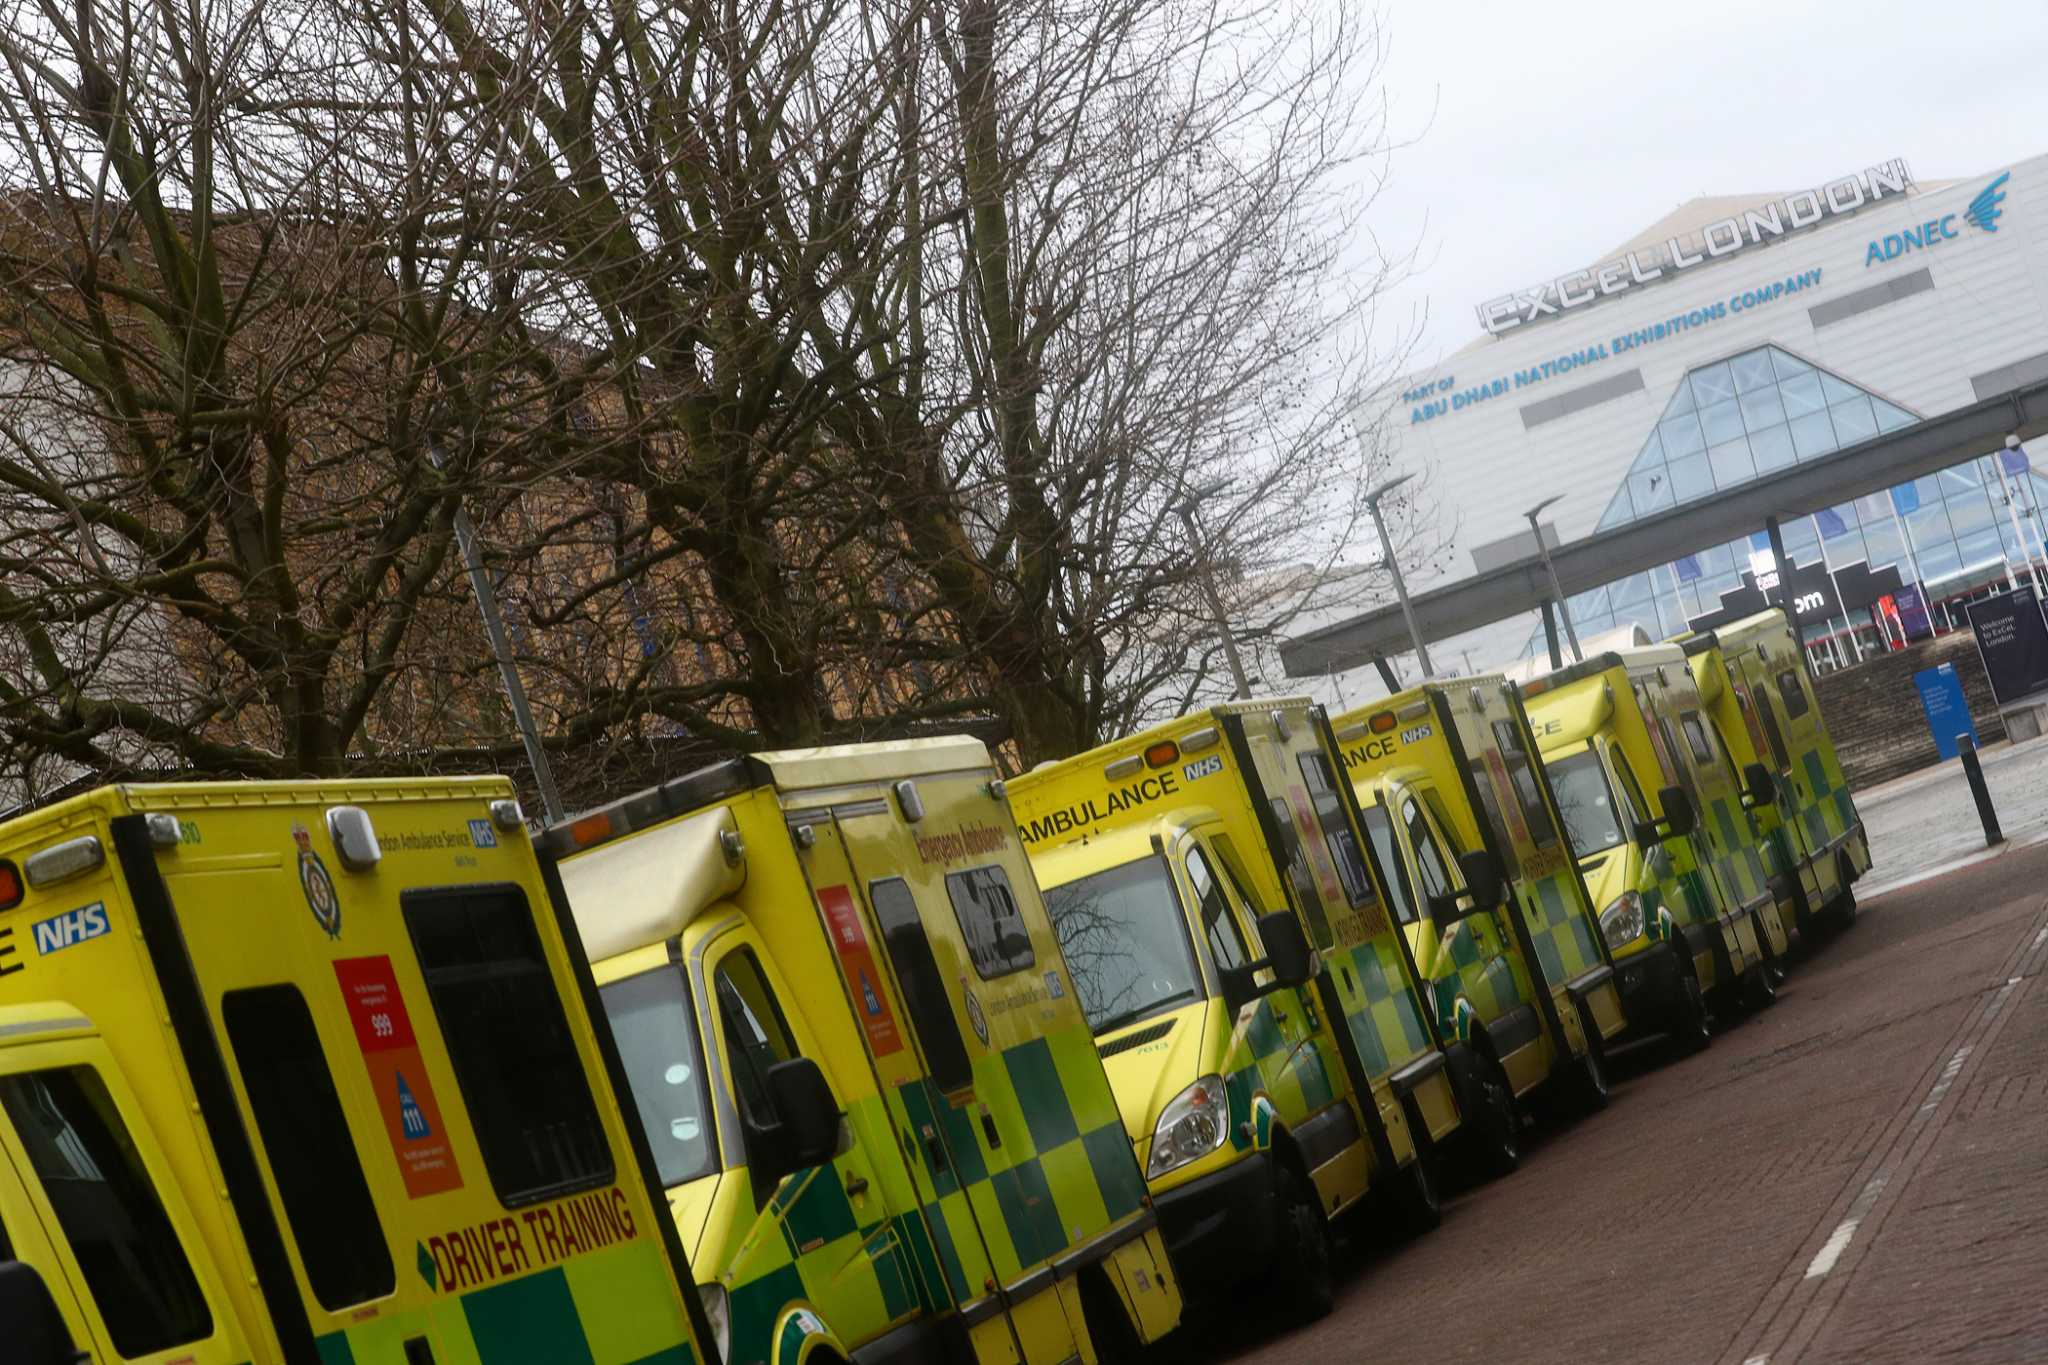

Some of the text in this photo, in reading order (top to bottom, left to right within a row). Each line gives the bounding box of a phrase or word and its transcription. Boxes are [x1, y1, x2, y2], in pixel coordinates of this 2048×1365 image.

[1668, 157, 1906, 270] LONDON
[1866, 213, 1959, 267] ADNEC
[1411, 267, 1823, 425] ABU DHABI NATIONAL EXHIBITIONS COMPANY
[1402, 376, 1455, 404] PART OF
[1402, 725, 1432, 745] NHS
[1184, 756, 1222, 780] NHS
[1017, 771, 1180, 845] AMBULANCE
[469, 819, 497, 848] NHS
[36, 903, 107, 954] NHS
[371, 1013, 394, 1037] 999
[403, 1107, 425, 1133] 111
[428, 1187, 638, 1294] DRIVER TRAINING
